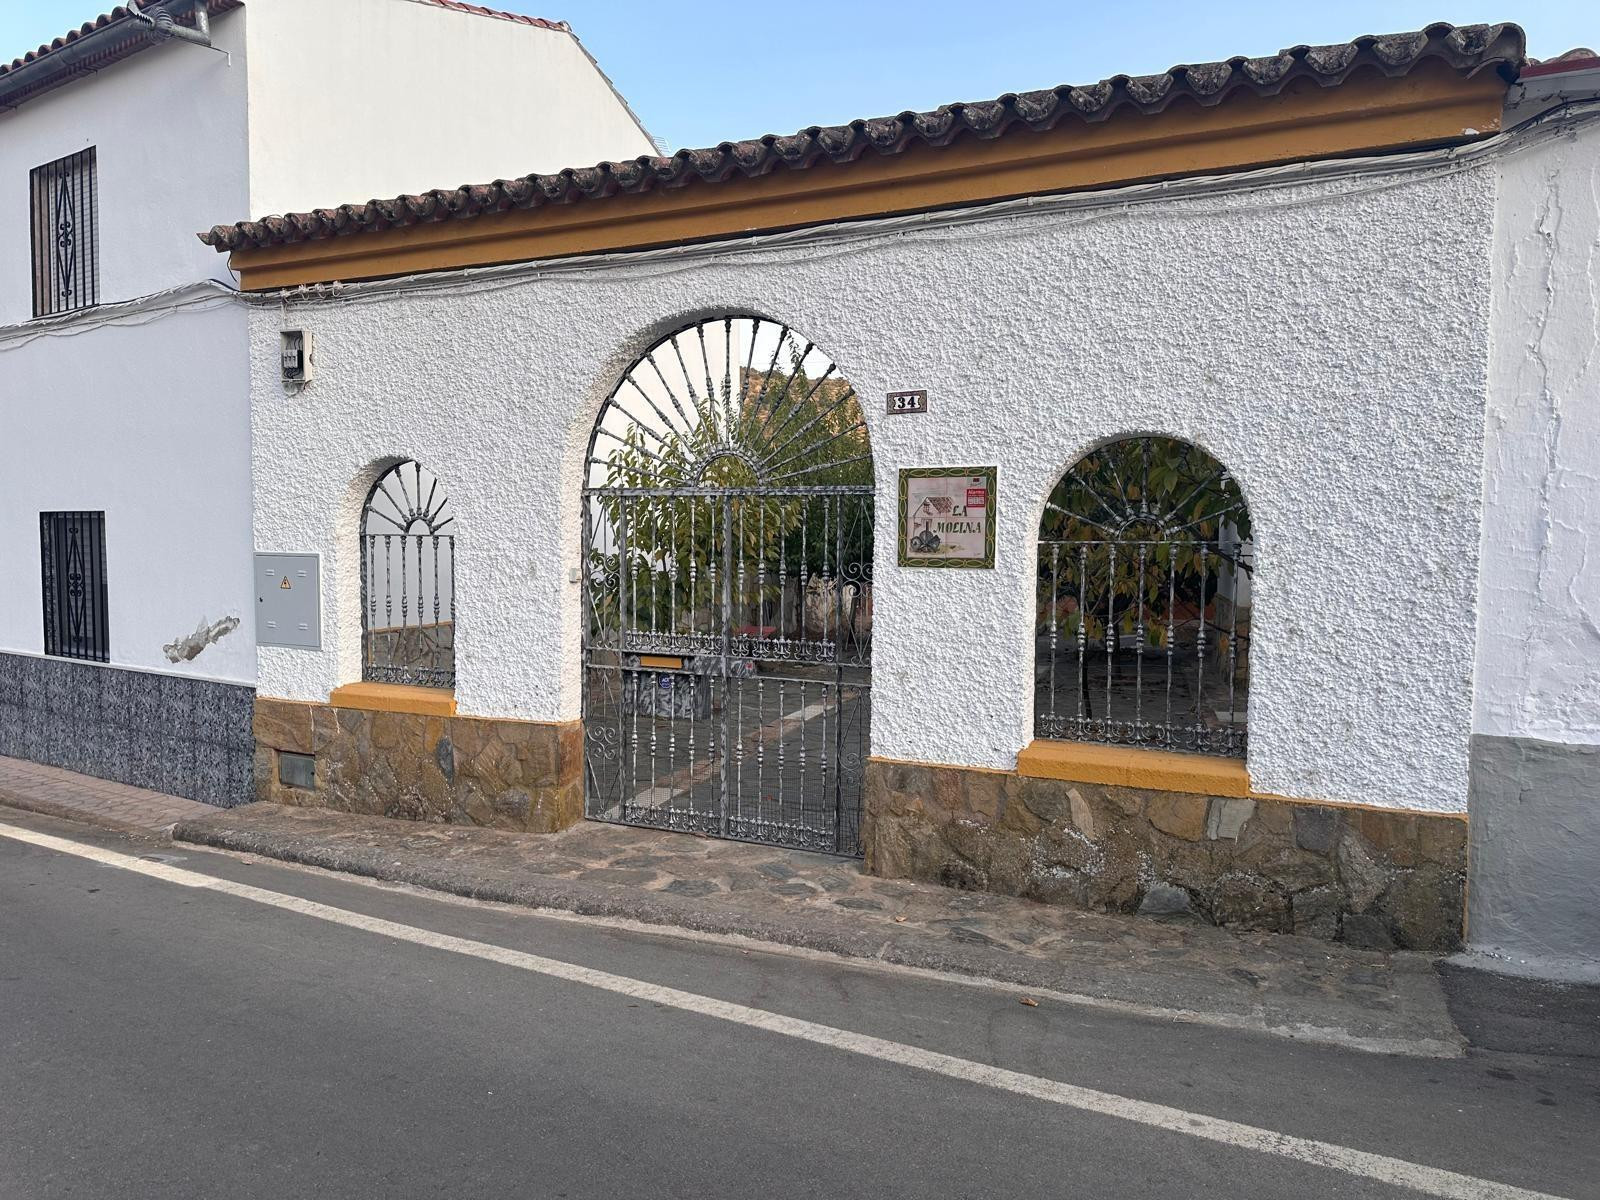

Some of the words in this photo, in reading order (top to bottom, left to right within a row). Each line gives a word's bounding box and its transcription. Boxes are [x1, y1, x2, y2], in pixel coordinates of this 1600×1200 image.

[897, 396, 916, 409] 34
[952, 505, 968, 517] LA
[933, 522, 982, 534] MOLINA
